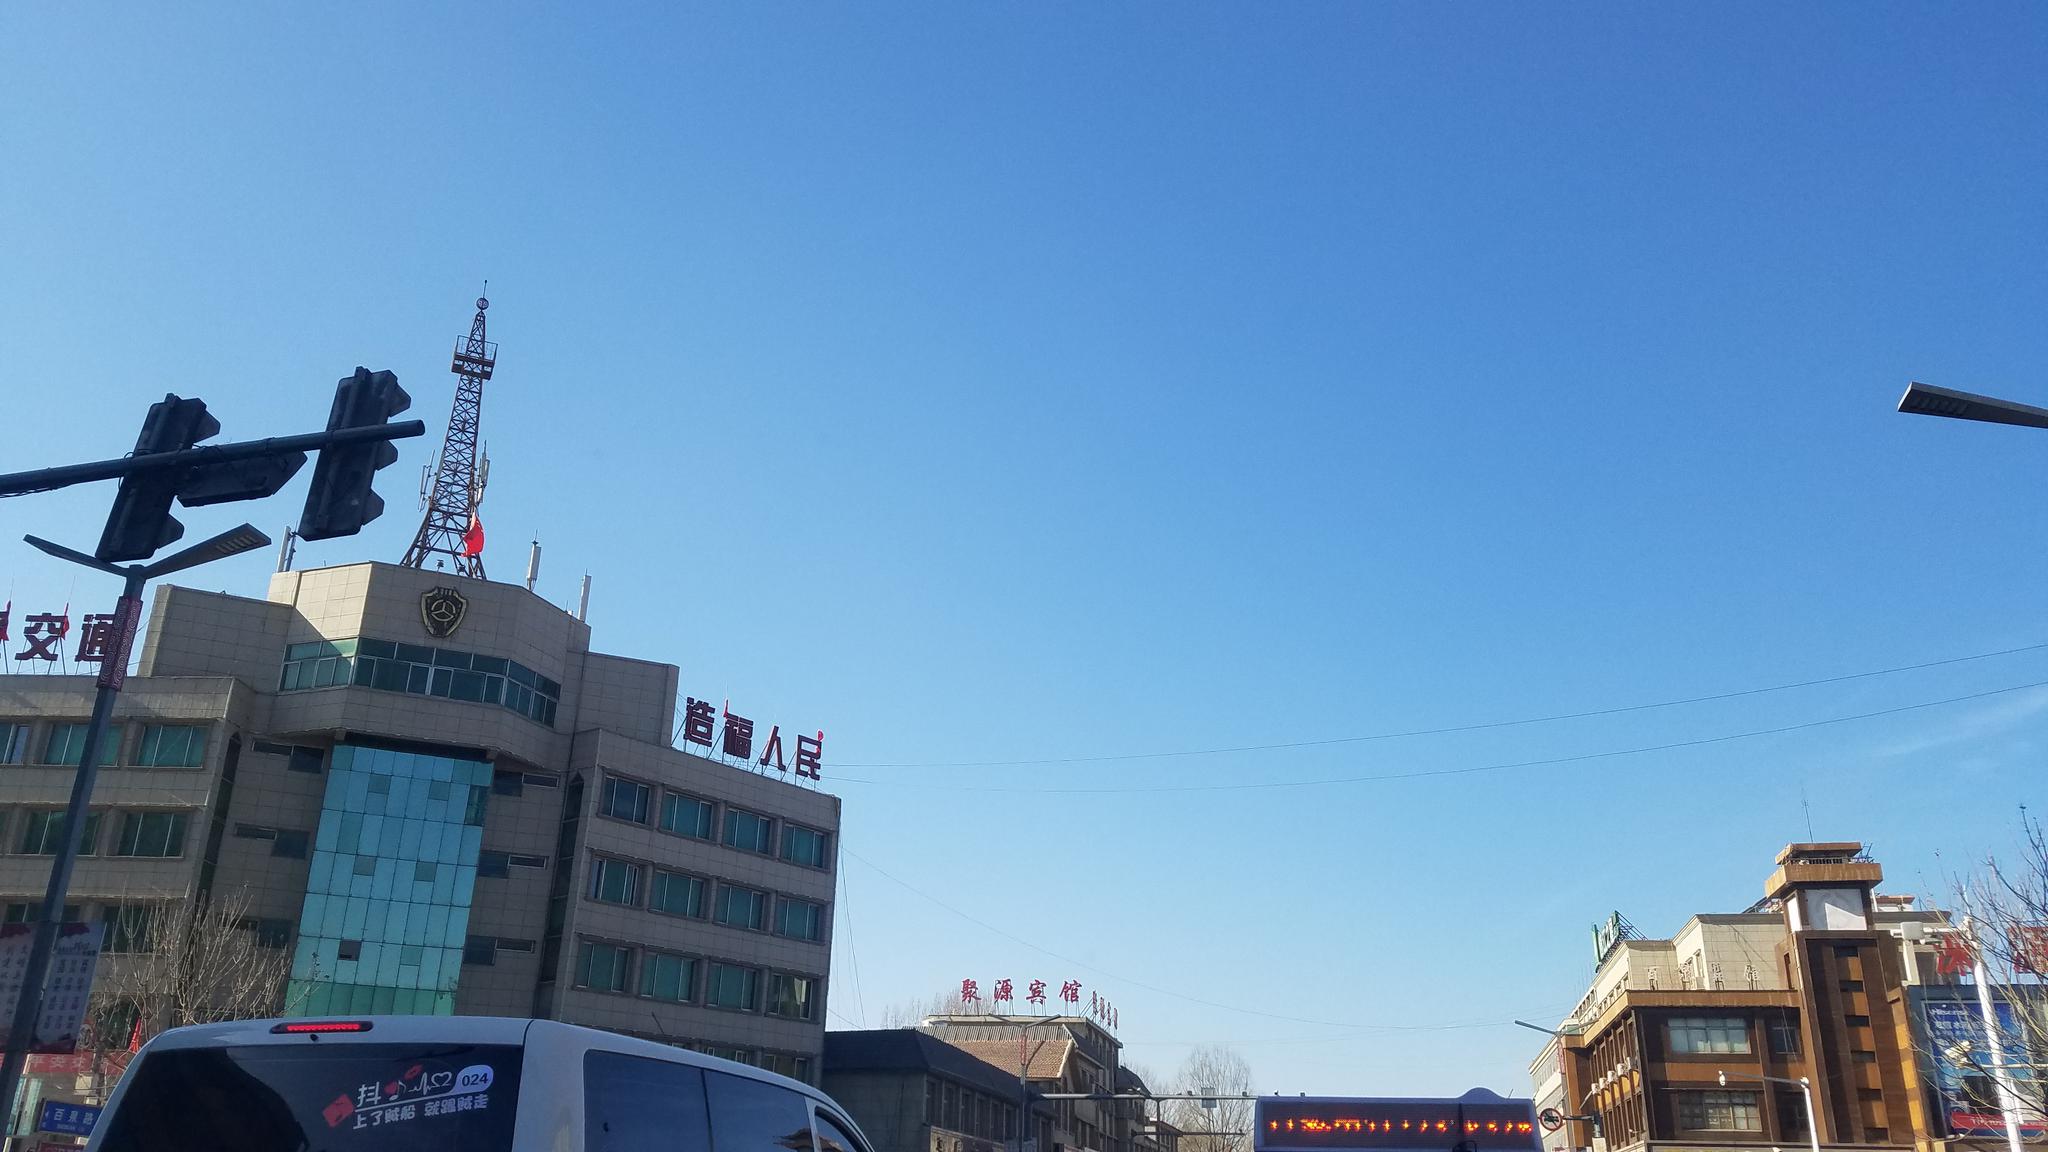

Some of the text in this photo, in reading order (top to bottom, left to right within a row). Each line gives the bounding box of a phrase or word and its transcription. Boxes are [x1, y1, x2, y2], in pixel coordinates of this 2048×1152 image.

[0, 611, 116, 662] 交通
[683, 696, 822, 781] 造福人民
[961, 978, 1082, 1004] 聚源宾馆
[462, 1073, 489, 1087] 024
[357, 1081, 382, 1107] 抖
[53, 1108, 94, 1126] 百泉路
[353, 1104, 416, 1130] 上了贼船
